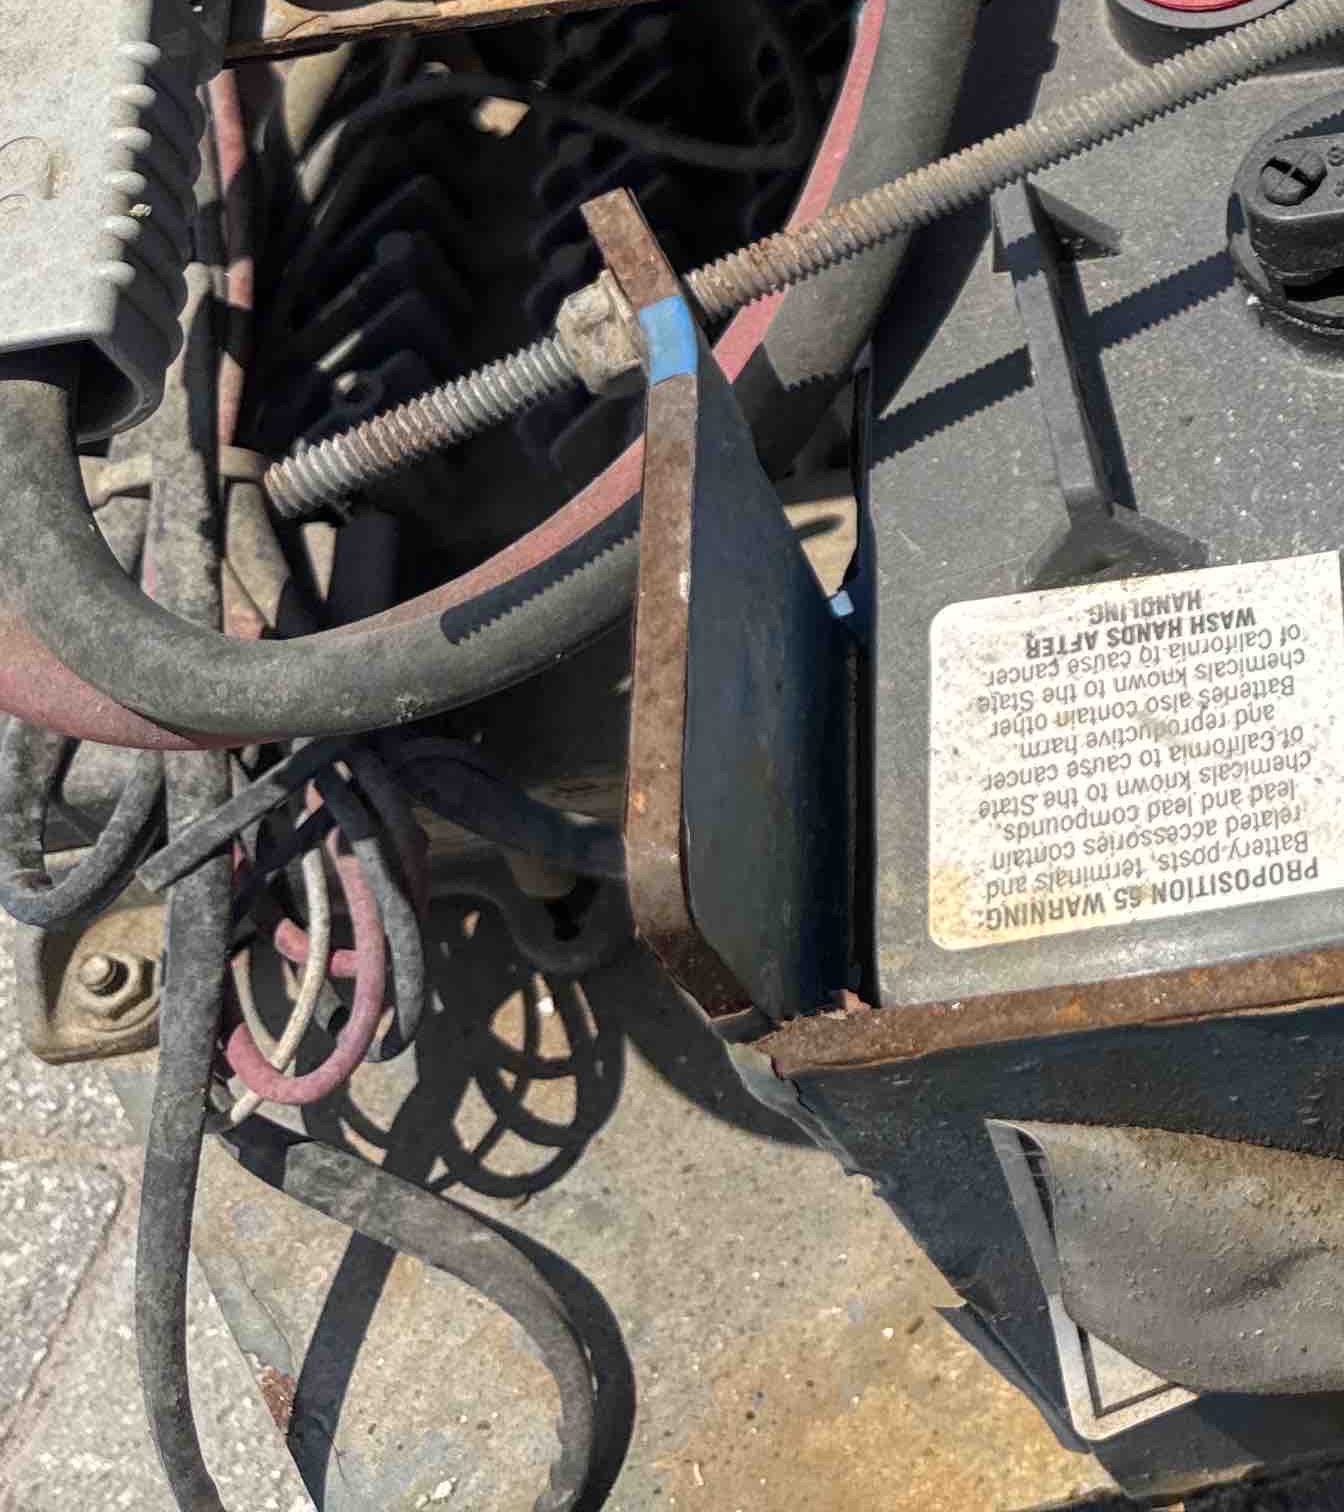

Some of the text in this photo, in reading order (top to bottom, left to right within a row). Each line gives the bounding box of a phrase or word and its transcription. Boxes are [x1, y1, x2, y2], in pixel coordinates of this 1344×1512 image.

[1025, 605, 1255, 660] WASH HANDS AFTER
[1067, 623, 1301, 675] of California to cause
[976, 647, 1305, 718] chemicals known to the State
[990, 674, 1295, 741] Batteries also contain other
[1235, 702, 1274, 729] and
[983, 724, 1303, 791] of California to cause cancer
[1086, 705, 1225, 751] reproductive
[978, 749, 1311, 822] chemicals known to the State
[1147, 779, 1294, 822] lead and lead
[985, 827, 1308, 903] Battery posts, terminals and
[991, 806, 1301, 873] related accessories contain
[976, 856, 1318, 932] PROPOSITION 65 WARNING:
